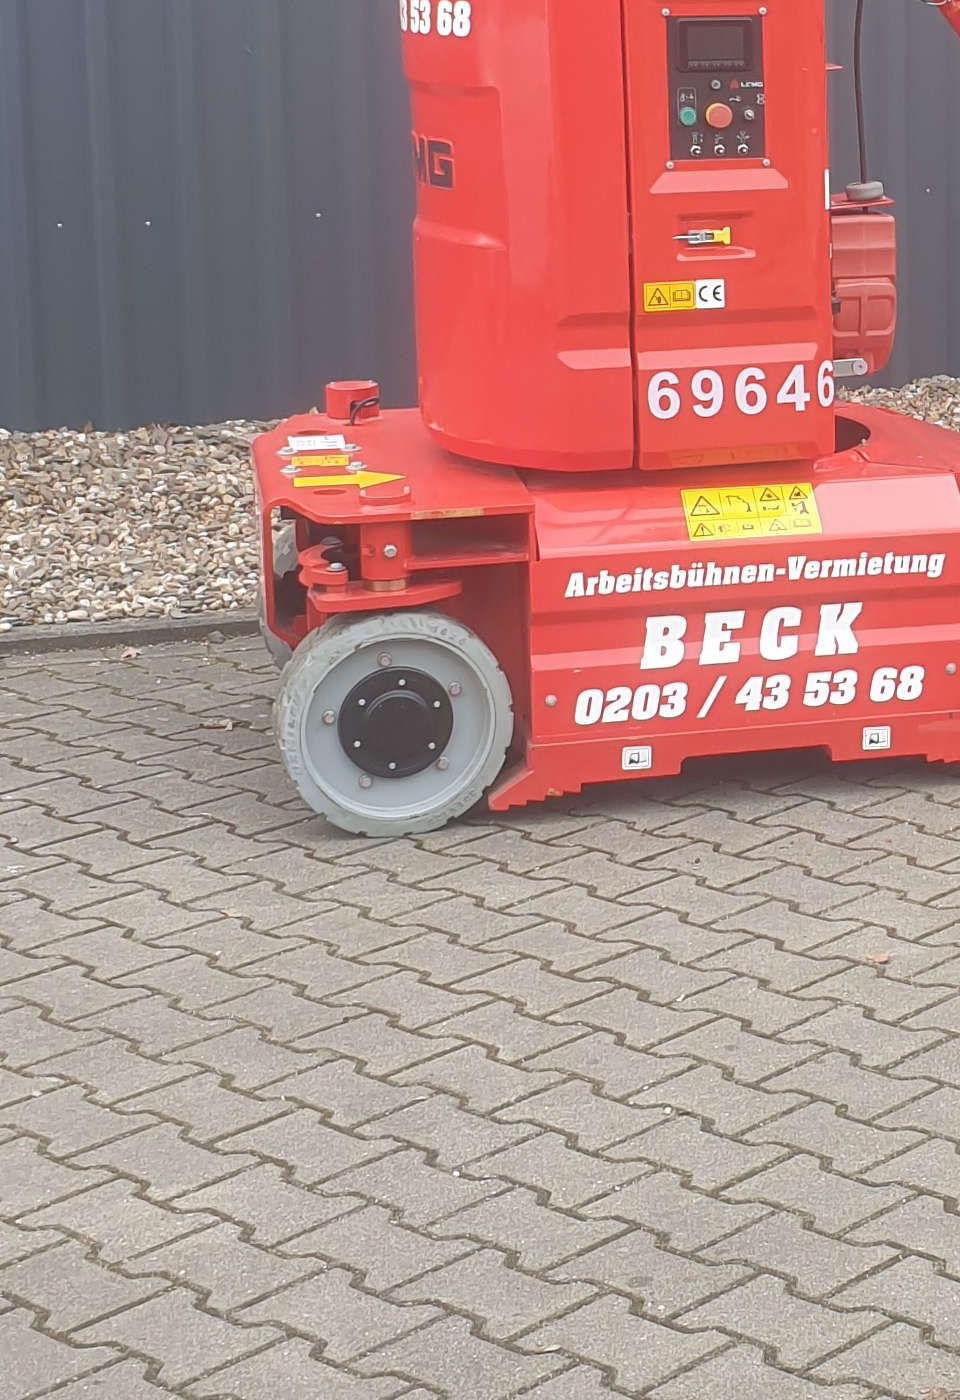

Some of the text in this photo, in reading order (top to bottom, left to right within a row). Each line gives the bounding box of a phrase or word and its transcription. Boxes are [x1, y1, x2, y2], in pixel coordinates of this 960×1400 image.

[436, 0, 472, 38] 68
[698, 285, 723, 303] CE
[647, 360, 835, 420] 69646
[564, 551, 946, 598] Arbeitsbühnen-Vermietung
[640, 602, 863, 670] BECK
[574, 682, 689, 726] 0203
[735, 674, 792, 712] 43
[803, 669, 858, 707] 53
[869, 665, 925, 703] 68
